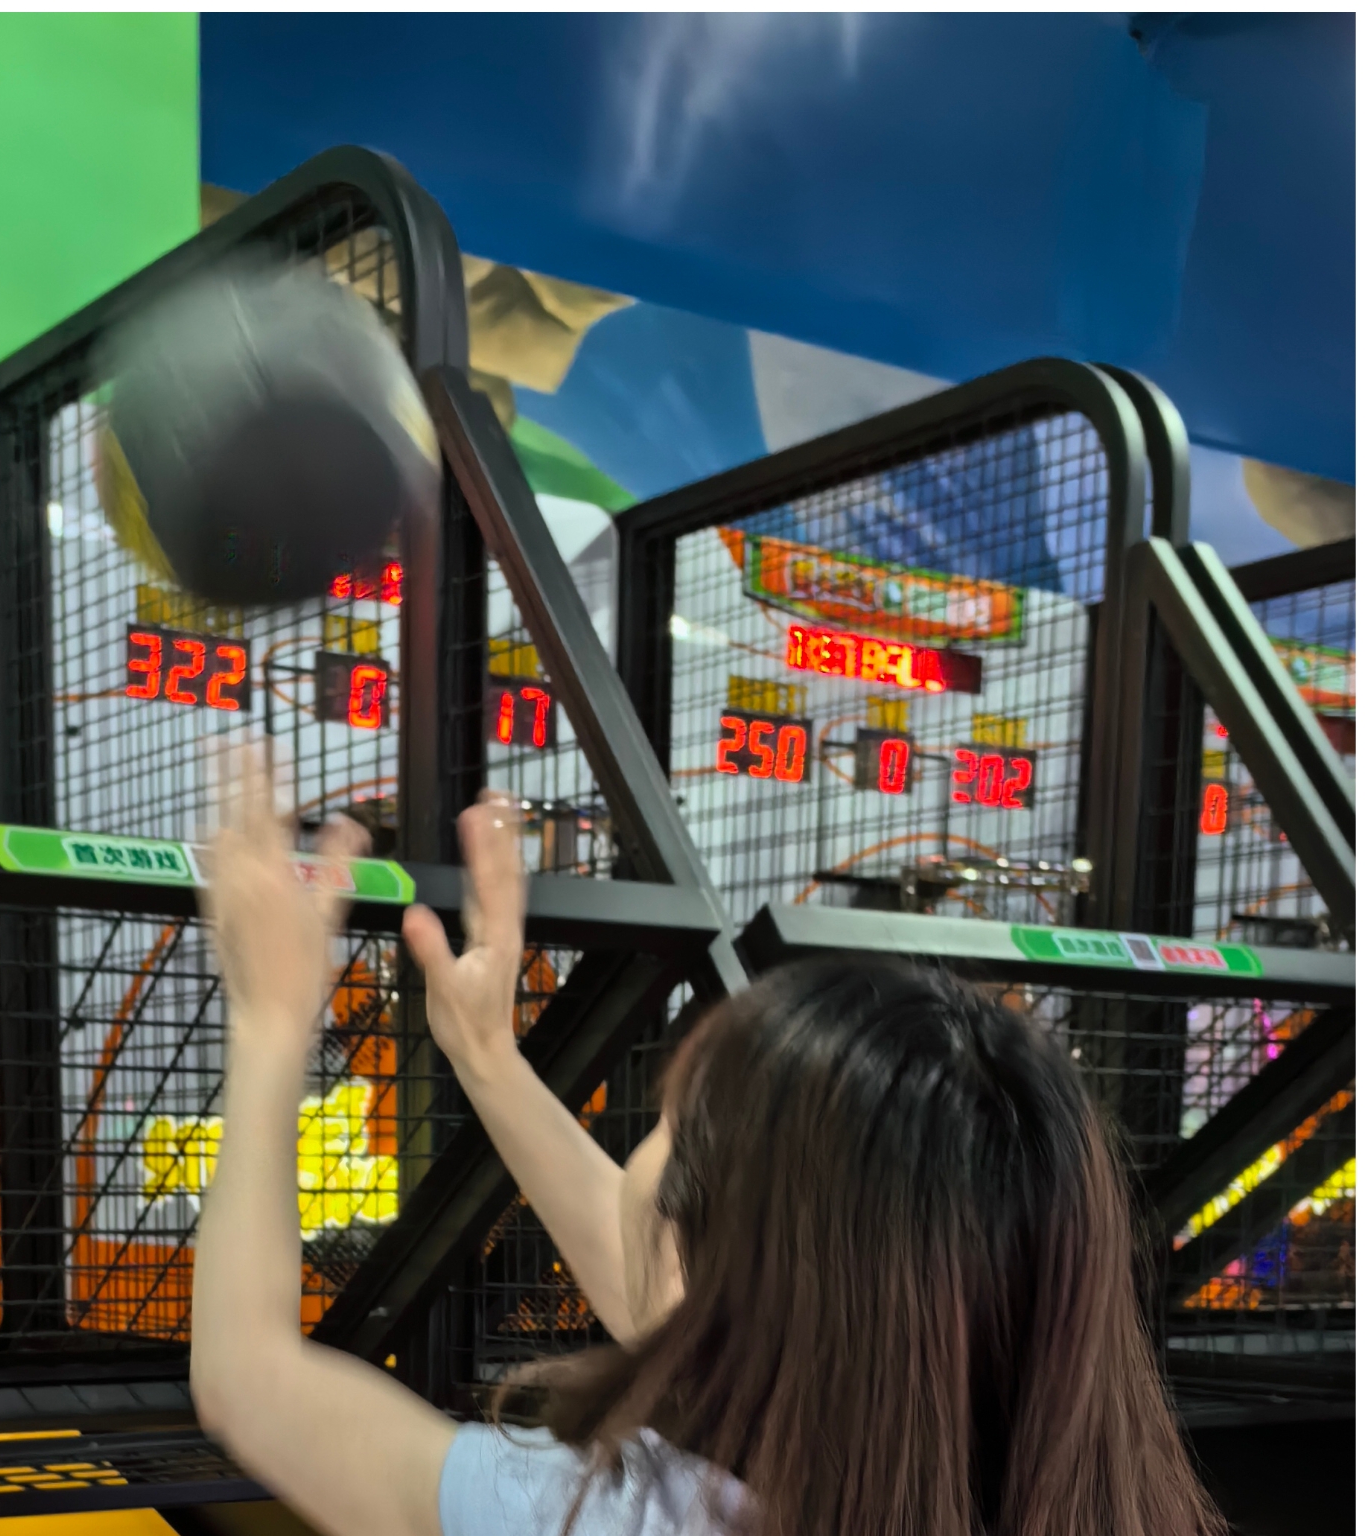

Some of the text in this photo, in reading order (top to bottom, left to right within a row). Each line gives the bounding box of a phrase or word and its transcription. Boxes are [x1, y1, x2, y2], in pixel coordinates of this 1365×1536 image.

[126, 631, 248, 712] 322
[348, 664, 388, 730] 0
[497, 688, 550, 748] 17
[716, 715, 807, 783] 250
[879, 739, 910, 795] 0
[952, 748, 1033, 809] 302
[71, 841, 181, 874] 首次游戏
